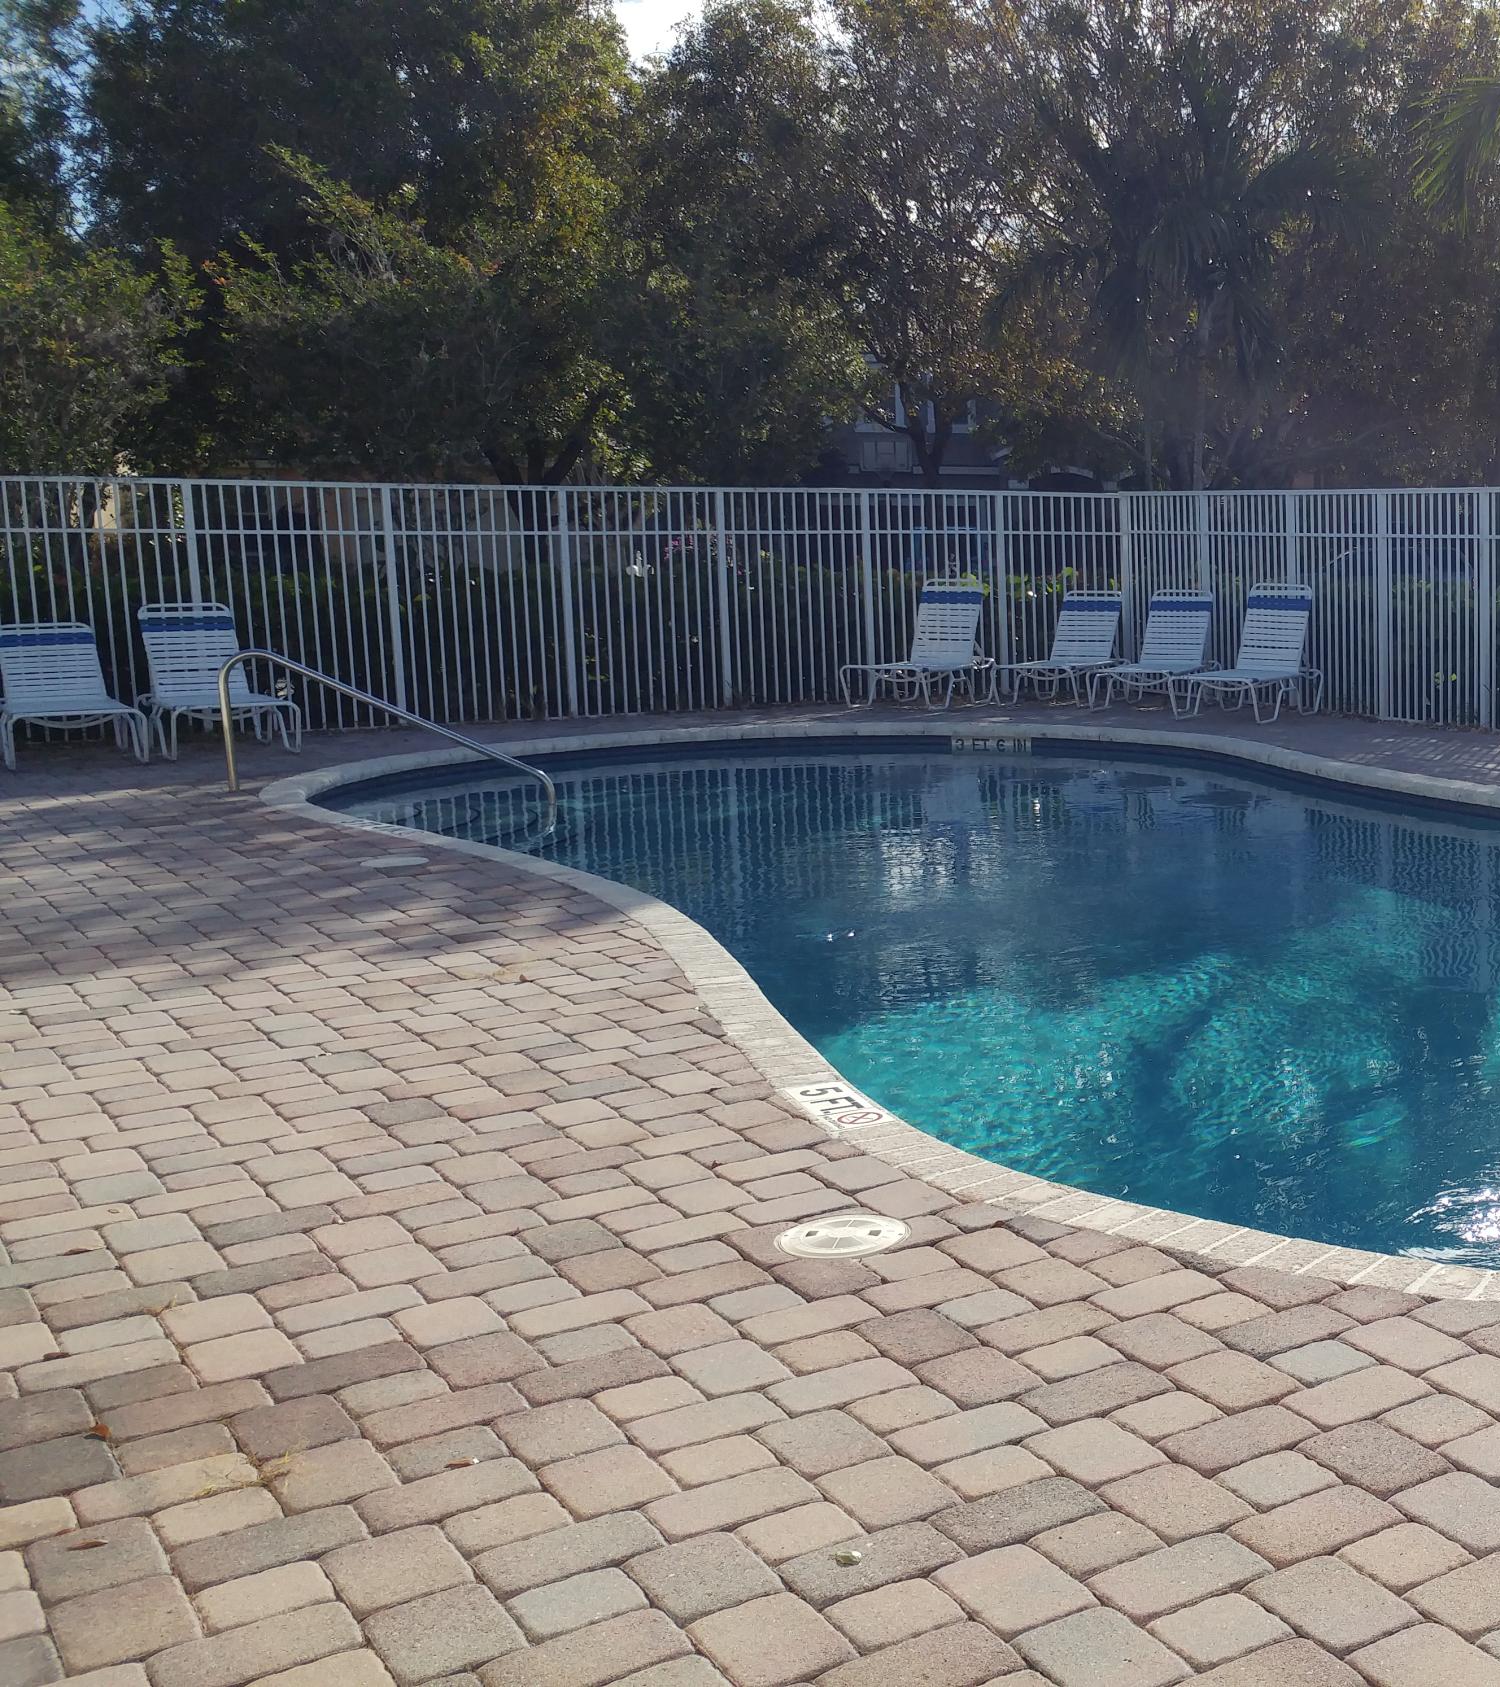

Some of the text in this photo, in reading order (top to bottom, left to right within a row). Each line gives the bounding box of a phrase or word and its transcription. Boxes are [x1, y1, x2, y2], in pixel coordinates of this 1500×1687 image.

[955, 738, 1027, 753] 3 FT 6 IN
[799, 1086, 843, 1097] 5
